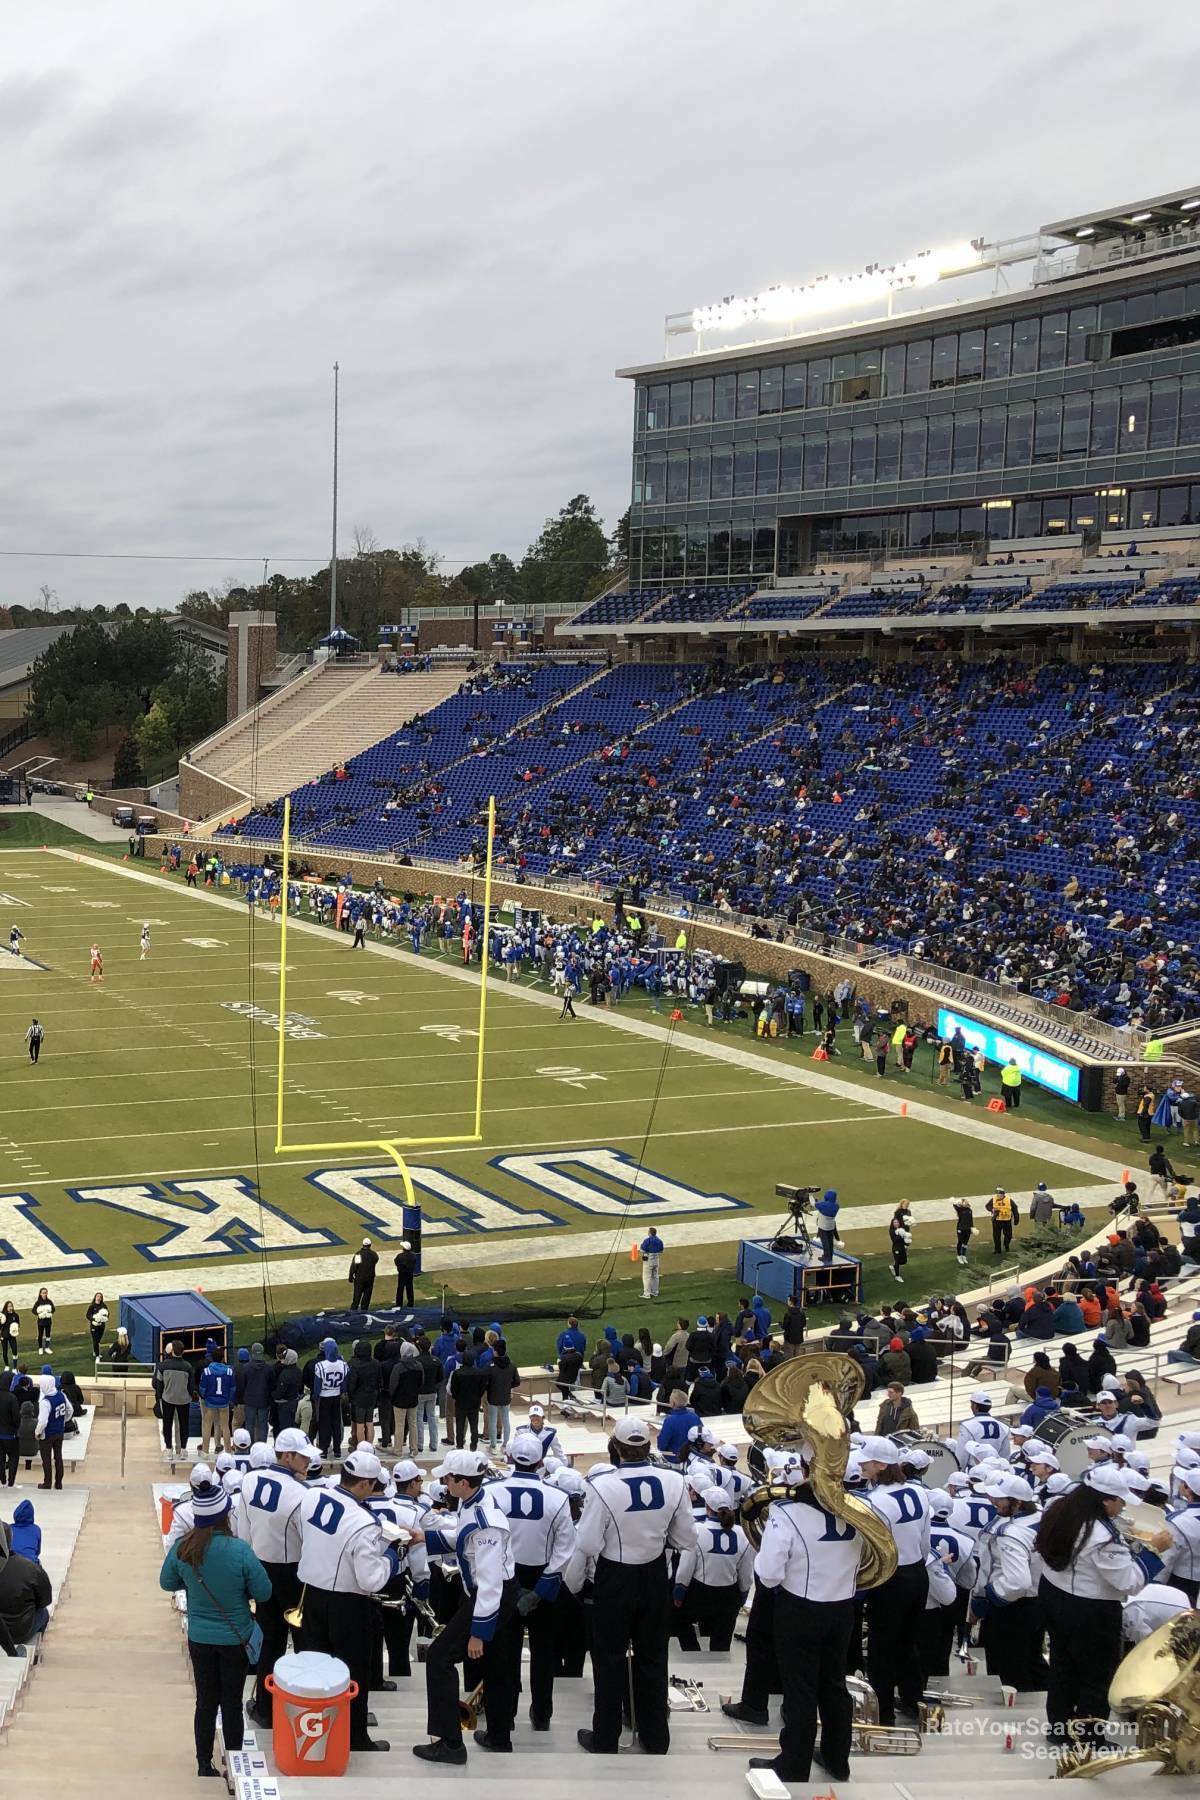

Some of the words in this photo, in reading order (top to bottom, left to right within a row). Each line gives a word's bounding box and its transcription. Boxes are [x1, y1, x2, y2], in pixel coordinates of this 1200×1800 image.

[535, 1066, 608, 1083] 10
[215, 1377, 222, 1395] 1
[325, 1371, 343, 1388] 52
[981, 1421, 1000, 1440] D
[249, 1475, 283, 1513] D
[505, 1487, 544, 1521] D
[621, 1475, 665, 1512] D
[888, 1487, 924, 1524] D
[307, 1492, 345, 1535] D
[965, 1502, 999, 1529] D
[477, 1538, 499, 1547] DUKE
[707, 1528, 738, 1555] D
[299, 1712, 323, 1737] G
